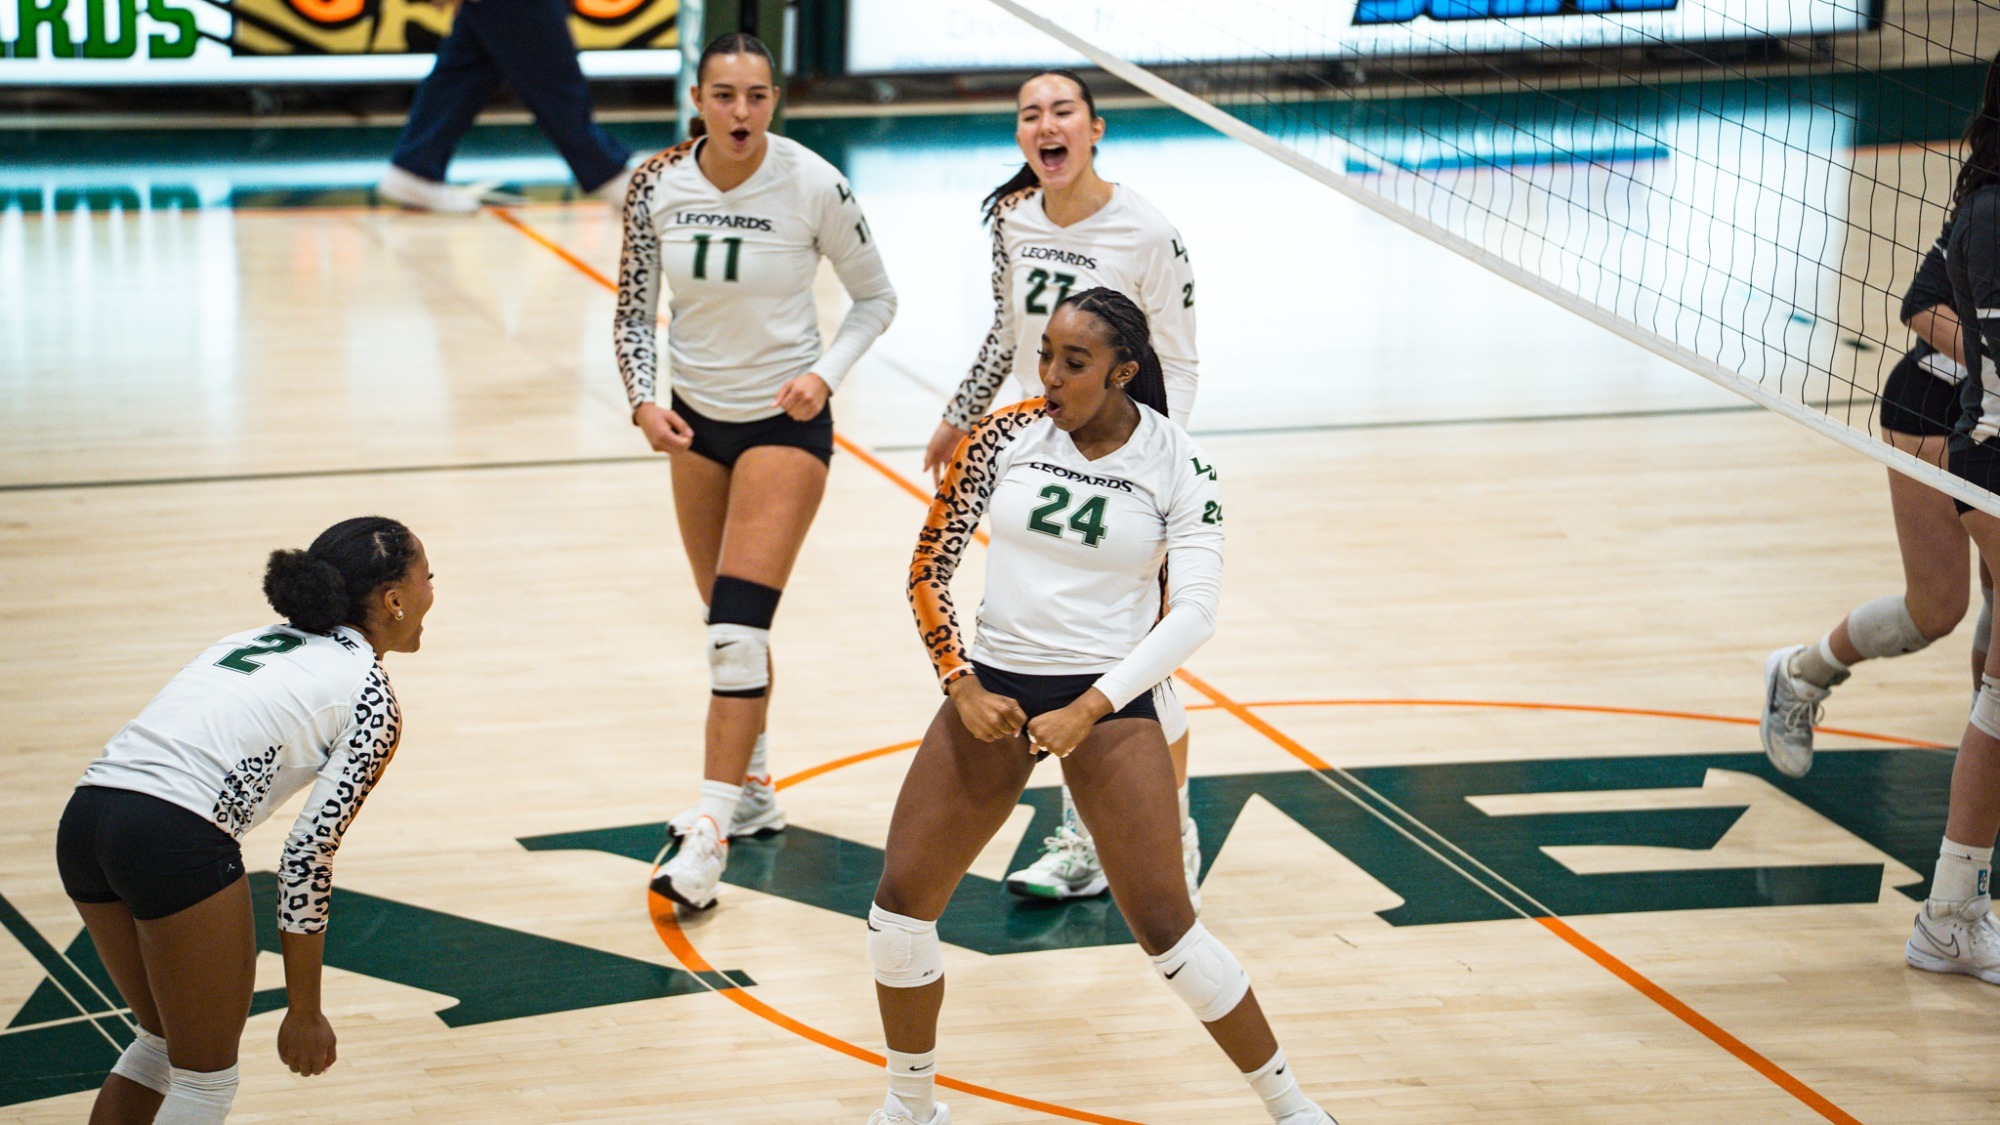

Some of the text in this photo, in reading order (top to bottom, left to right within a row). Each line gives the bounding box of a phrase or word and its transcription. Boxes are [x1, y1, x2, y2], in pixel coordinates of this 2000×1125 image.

[676, 212, 773, 232] LEOPARDS
[691, 233, 743, 282] 11
[1021, 246, 1098, 270] LEOPARDS
[1025, 267, 1076, 315] 27
[1029, 461, 1134, 494] LEOPARDS
[1027, 482, 1109, 549] 24
[213, 632, 307, 676] 2
